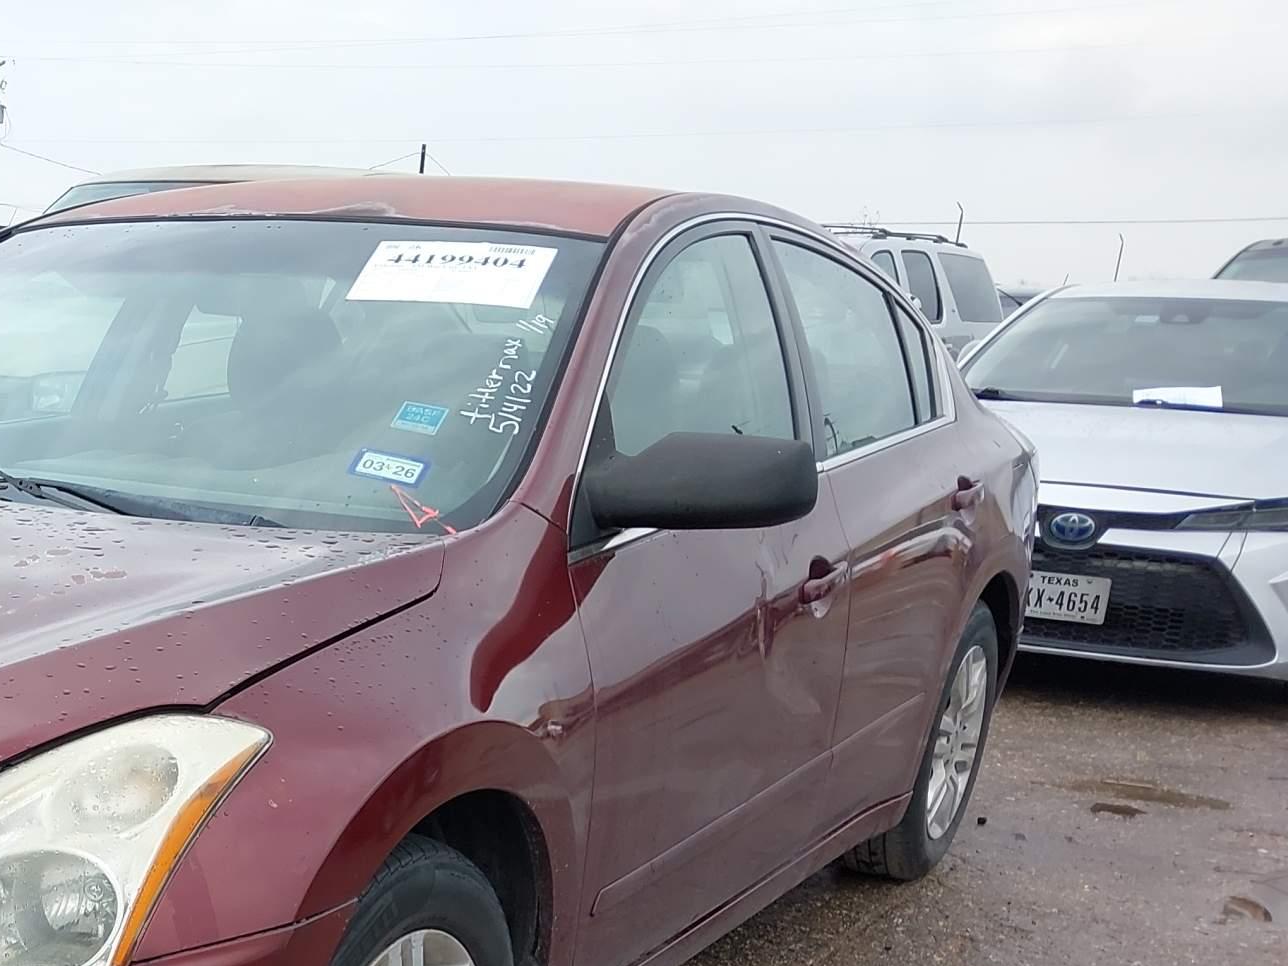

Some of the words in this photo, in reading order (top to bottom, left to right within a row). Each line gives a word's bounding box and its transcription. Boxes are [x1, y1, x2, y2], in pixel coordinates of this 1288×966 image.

[387, 252, 527, 269] 44199404
[362, 458, 385, 472] 03
[392, 465, 416, 479] 26
[1040, 575, 1079, 588] TEXAS
